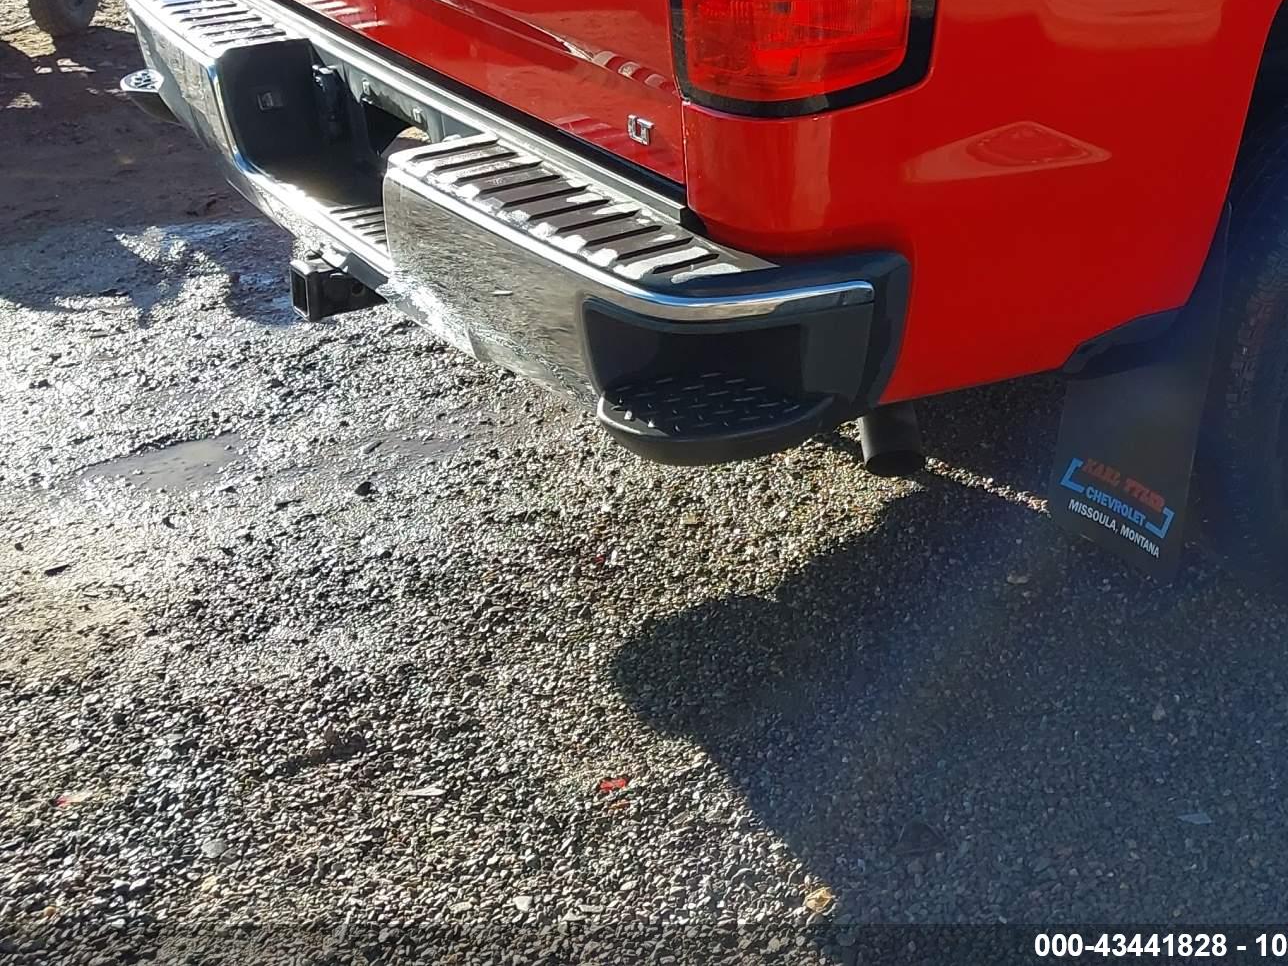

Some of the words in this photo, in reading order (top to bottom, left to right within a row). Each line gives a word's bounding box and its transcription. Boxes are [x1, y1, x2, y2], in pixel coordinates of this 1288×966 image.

[627, 114, 655, 145] LT
[1086, 487, 1147, 526] CHEVROLET
[1068, 499, 1119, 534] MISSOULA,
[1119, 525, 1160, 558] MONTANA
